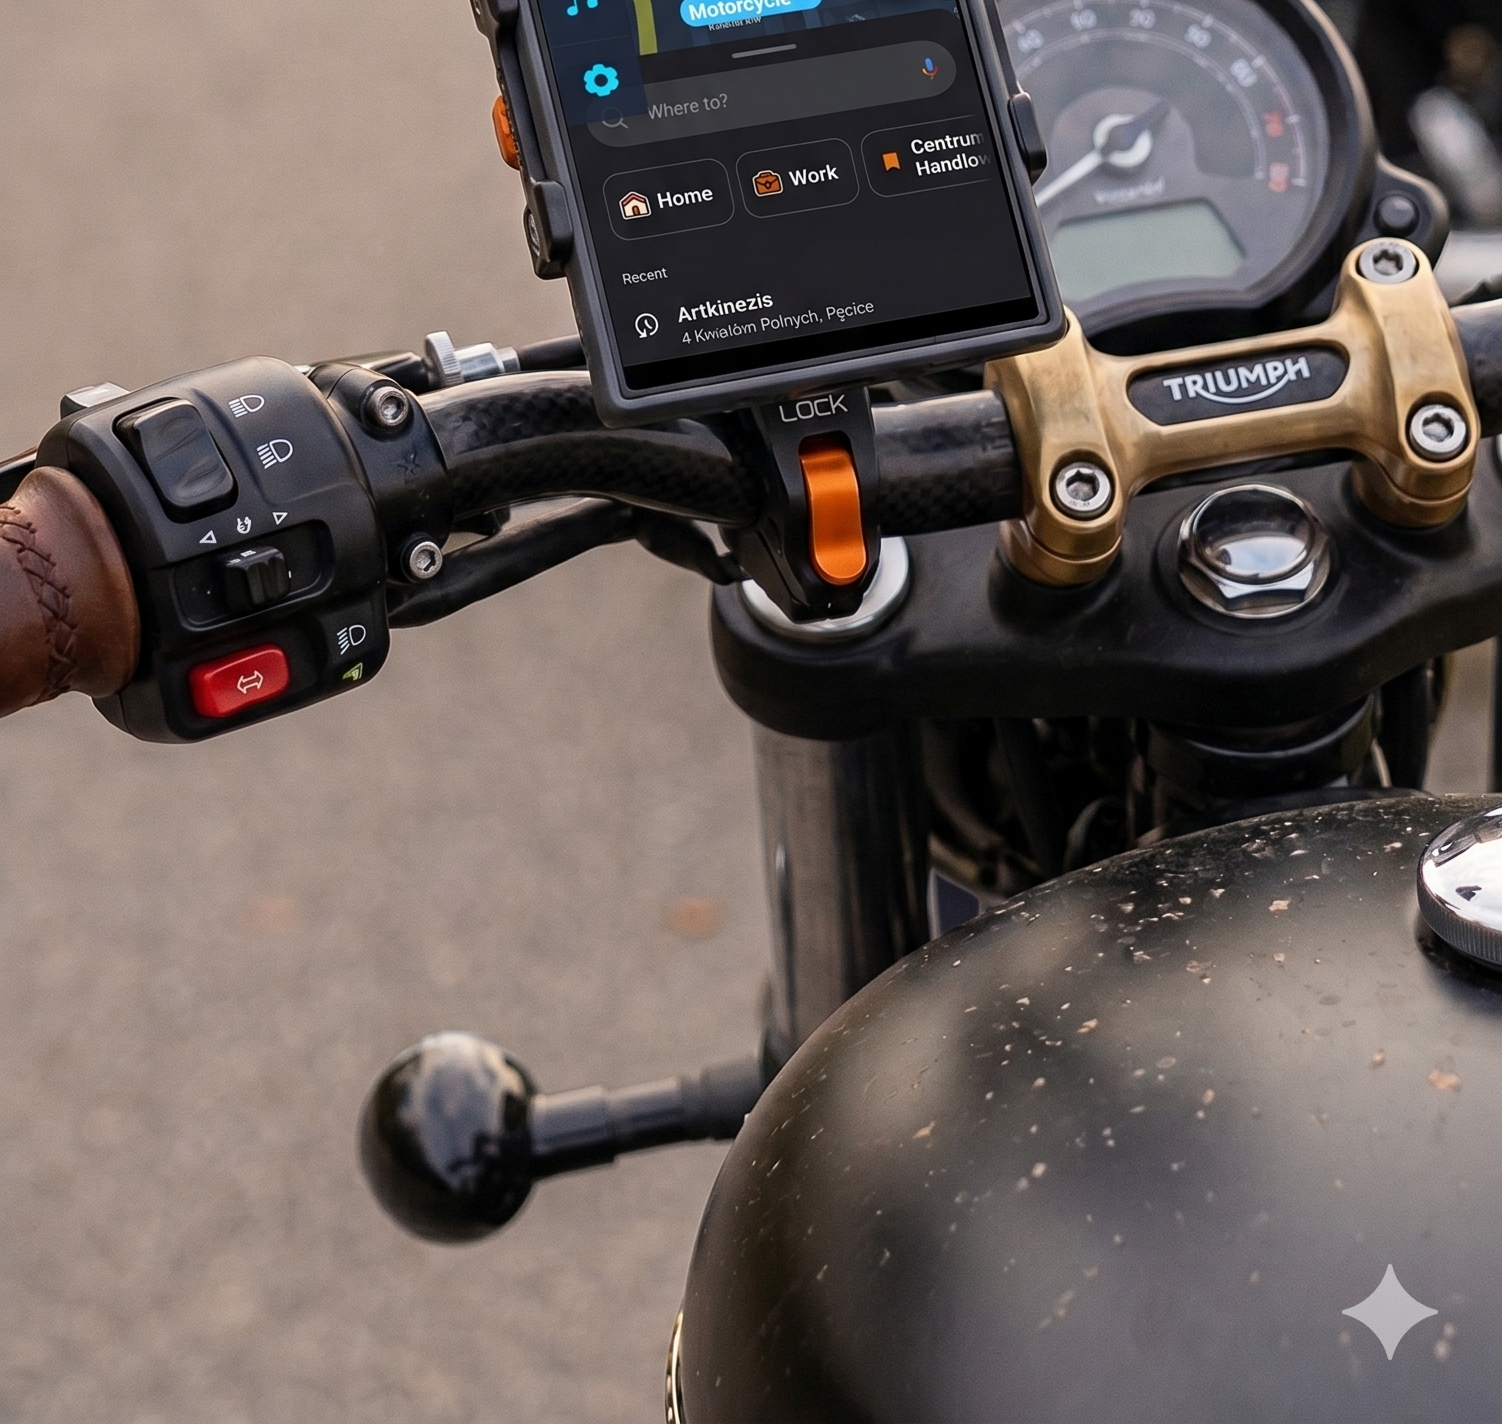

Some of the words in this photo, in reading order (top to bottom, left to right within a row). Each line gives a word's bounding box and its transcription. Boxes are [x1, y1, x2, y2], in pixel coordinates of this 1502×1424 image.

[648, 100, 700, 120] Where
[703, 93, 729, 111] to?
[910, 132, 984, 154] Centrum
[788, 164, 839, 186] Work
[915, 153, 991, 177] Handlow
[657, 188, 713, 209] Home
[622, 267, 668, 285] Recent
[678, 293, 774, 323] Artkinezis
[681, 332, 692, 345] 4
[760, 310, 823, 334] Polnych,
[825, 301, 875, 322] Pęcice
[1162, 356, 1311, 404] TRIUMPH
[779, 394, 848, 422] LOCK
